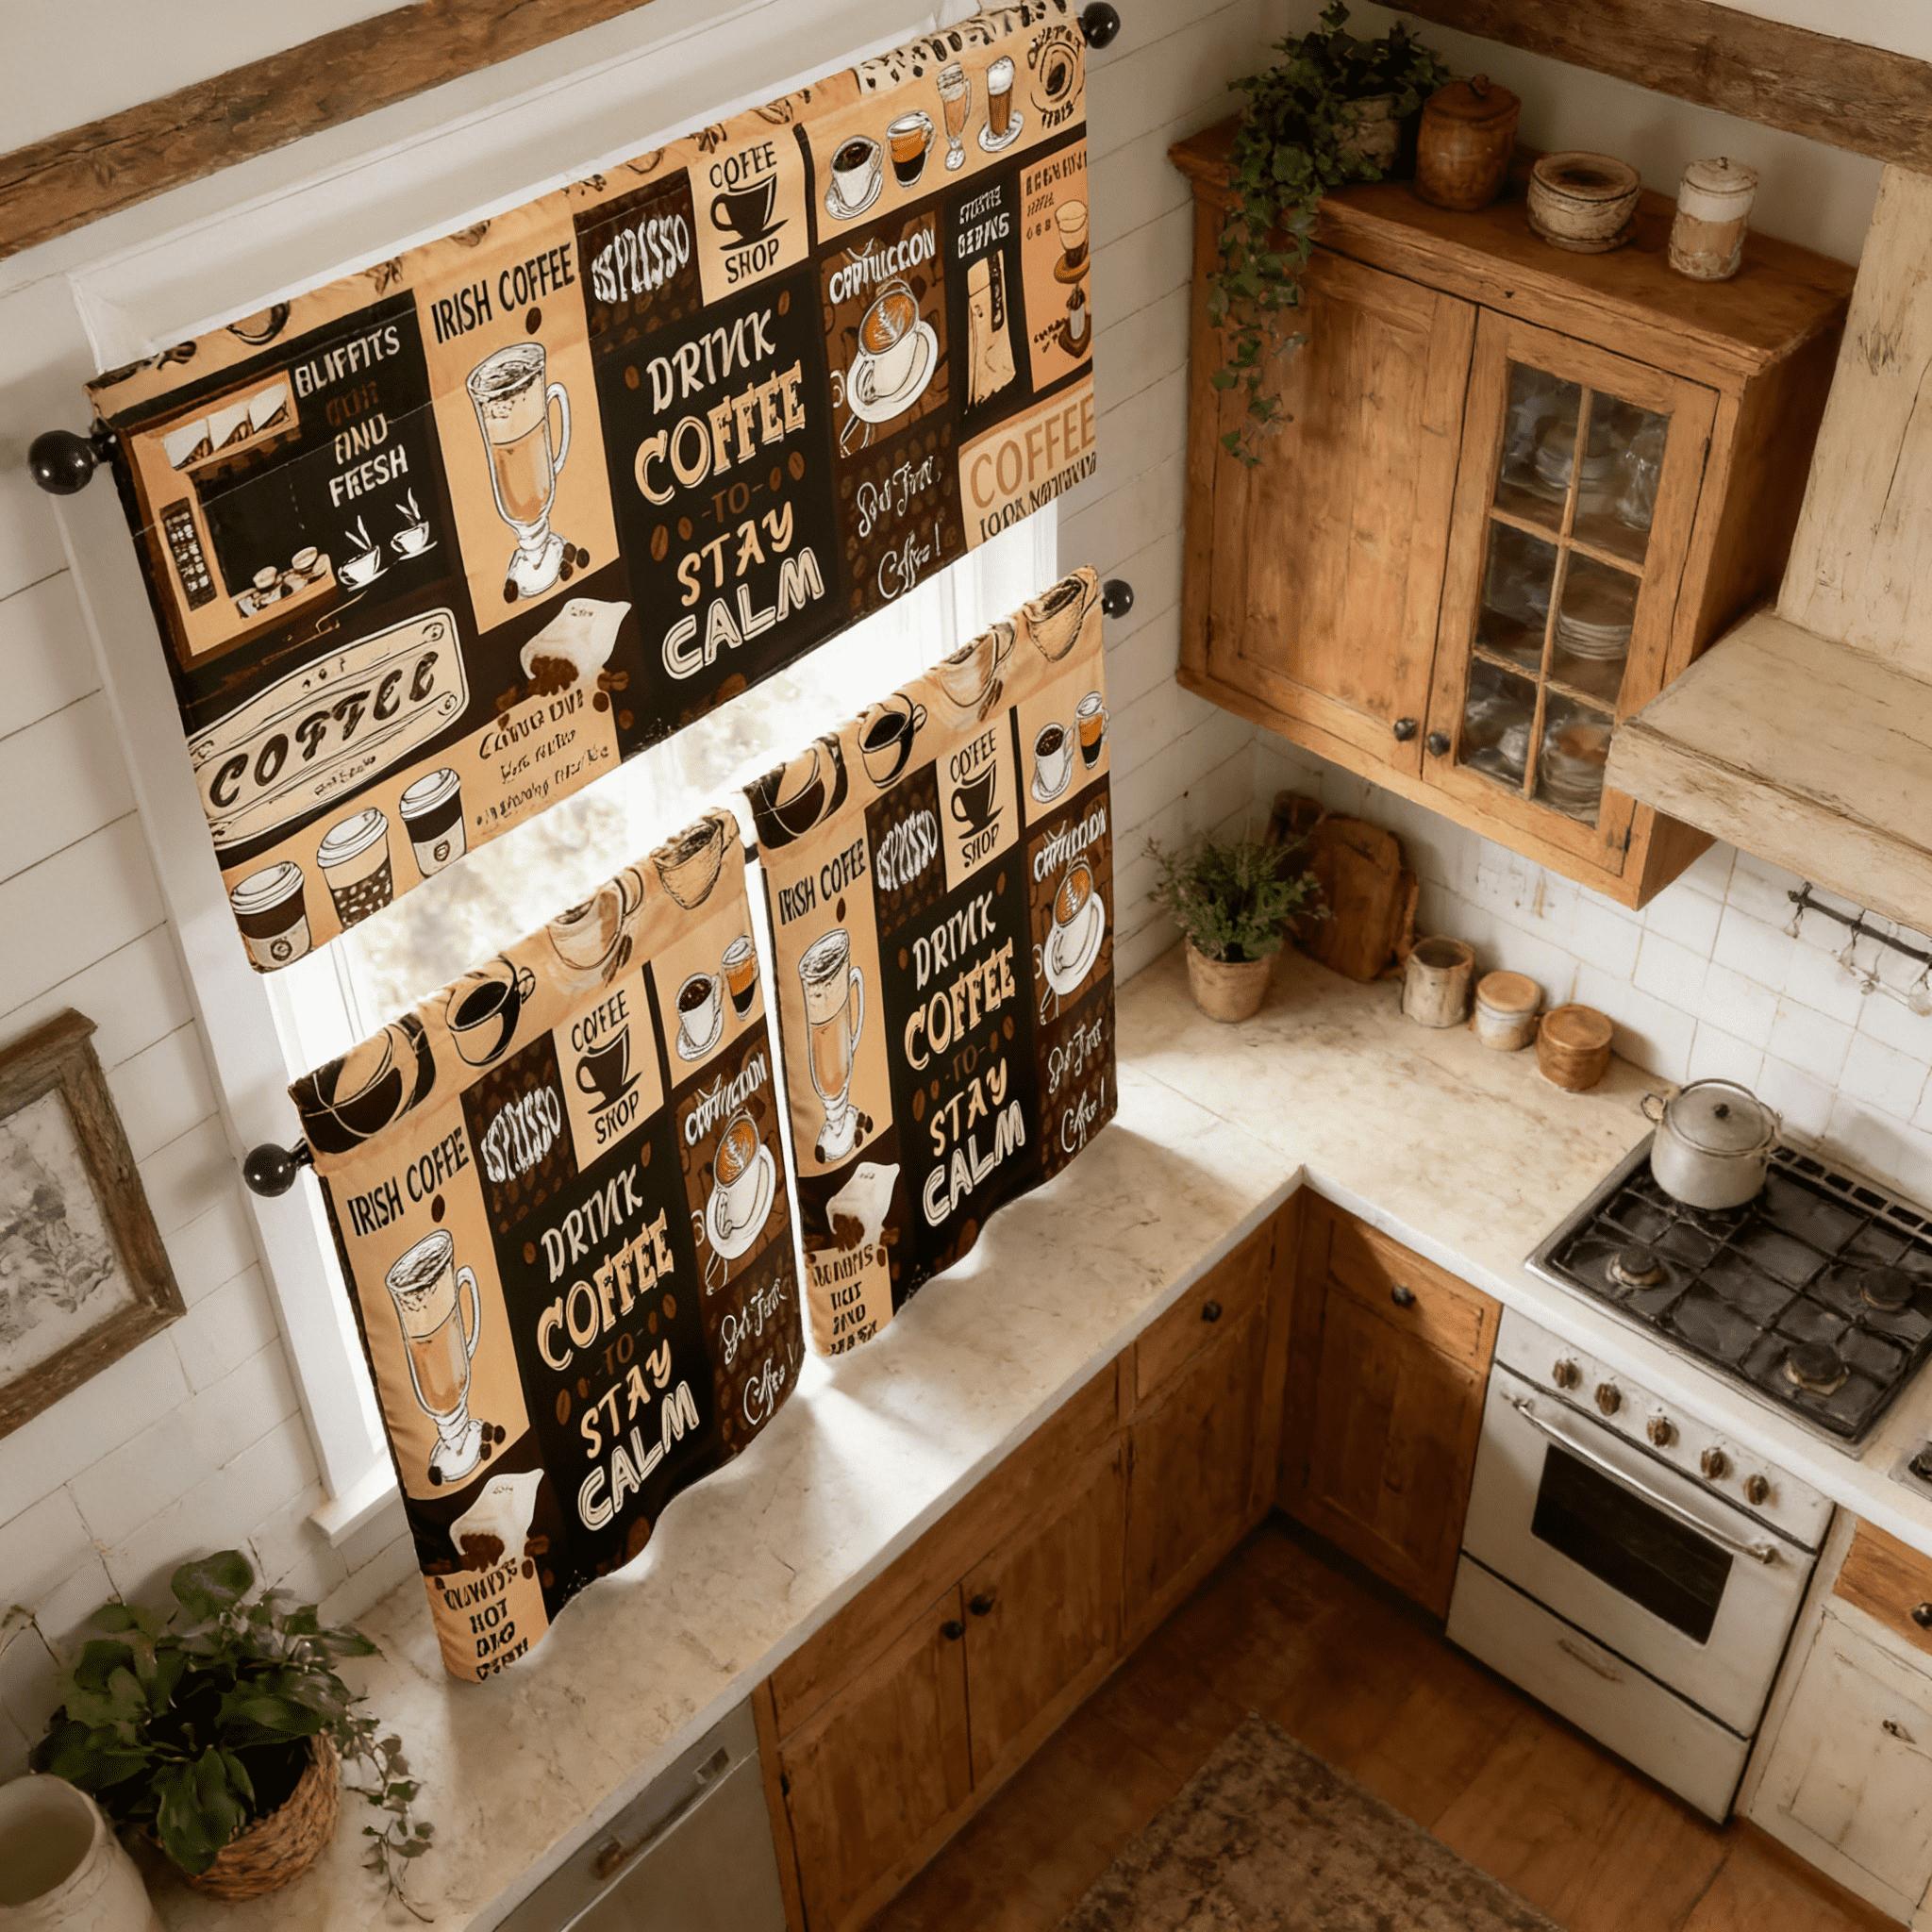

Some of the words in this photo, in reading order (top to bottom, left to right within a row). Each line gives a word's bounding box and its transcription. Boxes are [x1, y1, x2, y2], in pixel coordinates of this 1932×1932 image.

[430, 279, 493, 344] IRISH
[498, 242, 575, 312] COFFEE
[724, 238, 779, 284] SHOP
[646, 308, 776, 415] DRINK
[329, 443, 408, 508] FRESH
[634, 358, 807, 507] COFFEE
[970, 392, 1097, 508] COFFEE
[676, 501, 794, 608] STAY
[661, 547, 825, 680] CALM
[912, 891, 996, 991] DRINK
[904, 936, 1016, 1072] COFFEE
[594, 1091, 640, 1144] SHOP
[922, 1099, 1026, 1227] CALM
[929, 1058, 1008, 1158] STAY
[347, 1175, 405, 1237] IRISH
[541, 1163, 643, 1283] DRINK
[537, 1207, 675, 1372] COFFEE
[580, 1339, 672, 1459] STAY
[577, 1380, 700, 1531] CALM
